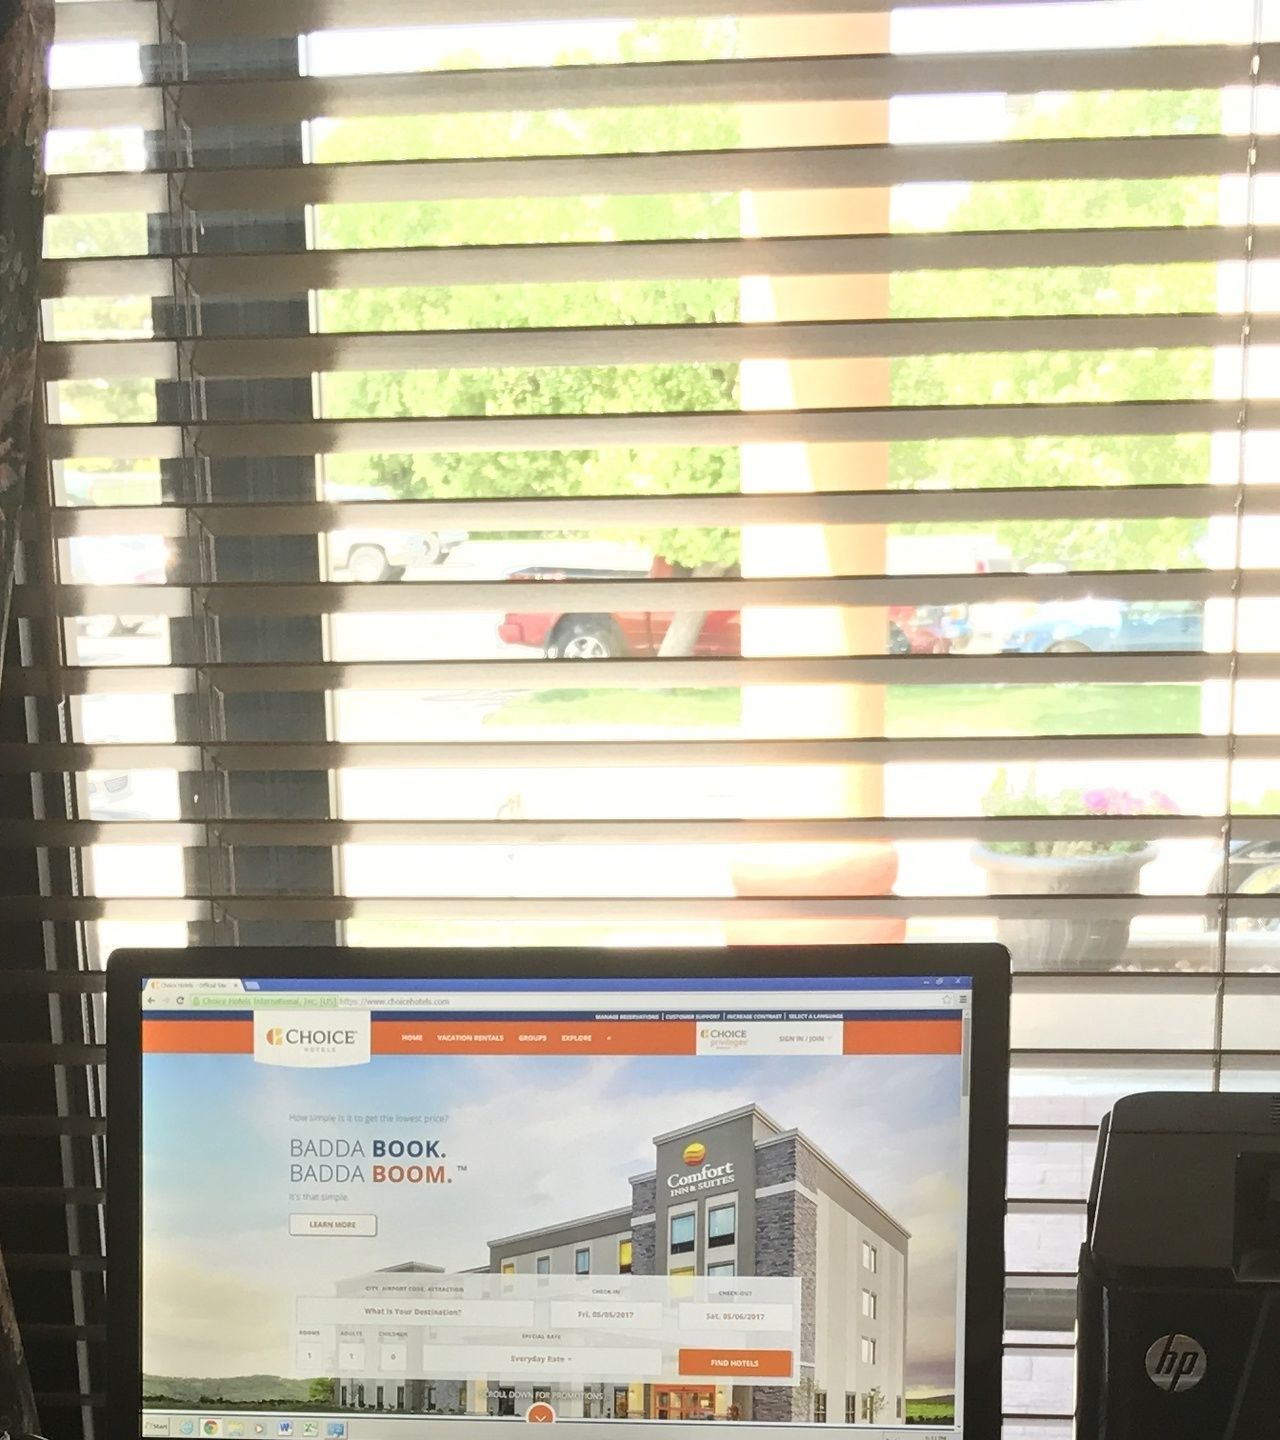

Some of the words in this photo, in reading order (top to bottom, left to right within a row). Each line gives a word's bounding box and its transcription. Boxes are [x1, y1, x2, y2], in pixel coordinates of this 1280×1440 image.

[285, 1028, 357, 1045] CHOICE
[401, 1034, 423, 1042] HOME
[437, 1034, 473, 1042] VACATION
[474, 1034, 505, 1042] RENTALS
[518, 1034, 548, 1042] GROUPS
[561, 1034, 593, 1042] EXPLORE
[710, 1029, 747, 1039] CHOICE
[779, 1035, 795, 1043] SIGN
[288, 1113, 308, 1122] How
[309, 1113, 337, 1124] simple
[354, 1114, 363, 1122] to
[365, 1114, 377, 1124] get
[379, 1114, 394, 1123] the
[290, 1138, 366, 1158] BADDA
[372, 1139, 447, 1159] BOOK.
[290, 1163, 366, 1183] BADDA
[372, 1165, 453, 1184] BOOM.
[667, 1161, 735, 1188] Comfort
[670, 1186, 689, 1198] INN
[697, 1174, 736, 1191] SUITES
[309, 1221, 334, 1229] LEARN
[335, 1221, 357, 1229] MORE
[364, 1307, 385, 1315] What
[710, 1359, 729, 1368] FIND
[729, 1359, 759, 1368] HOTELS
[1154, 1333, 1200, 1391] hp
